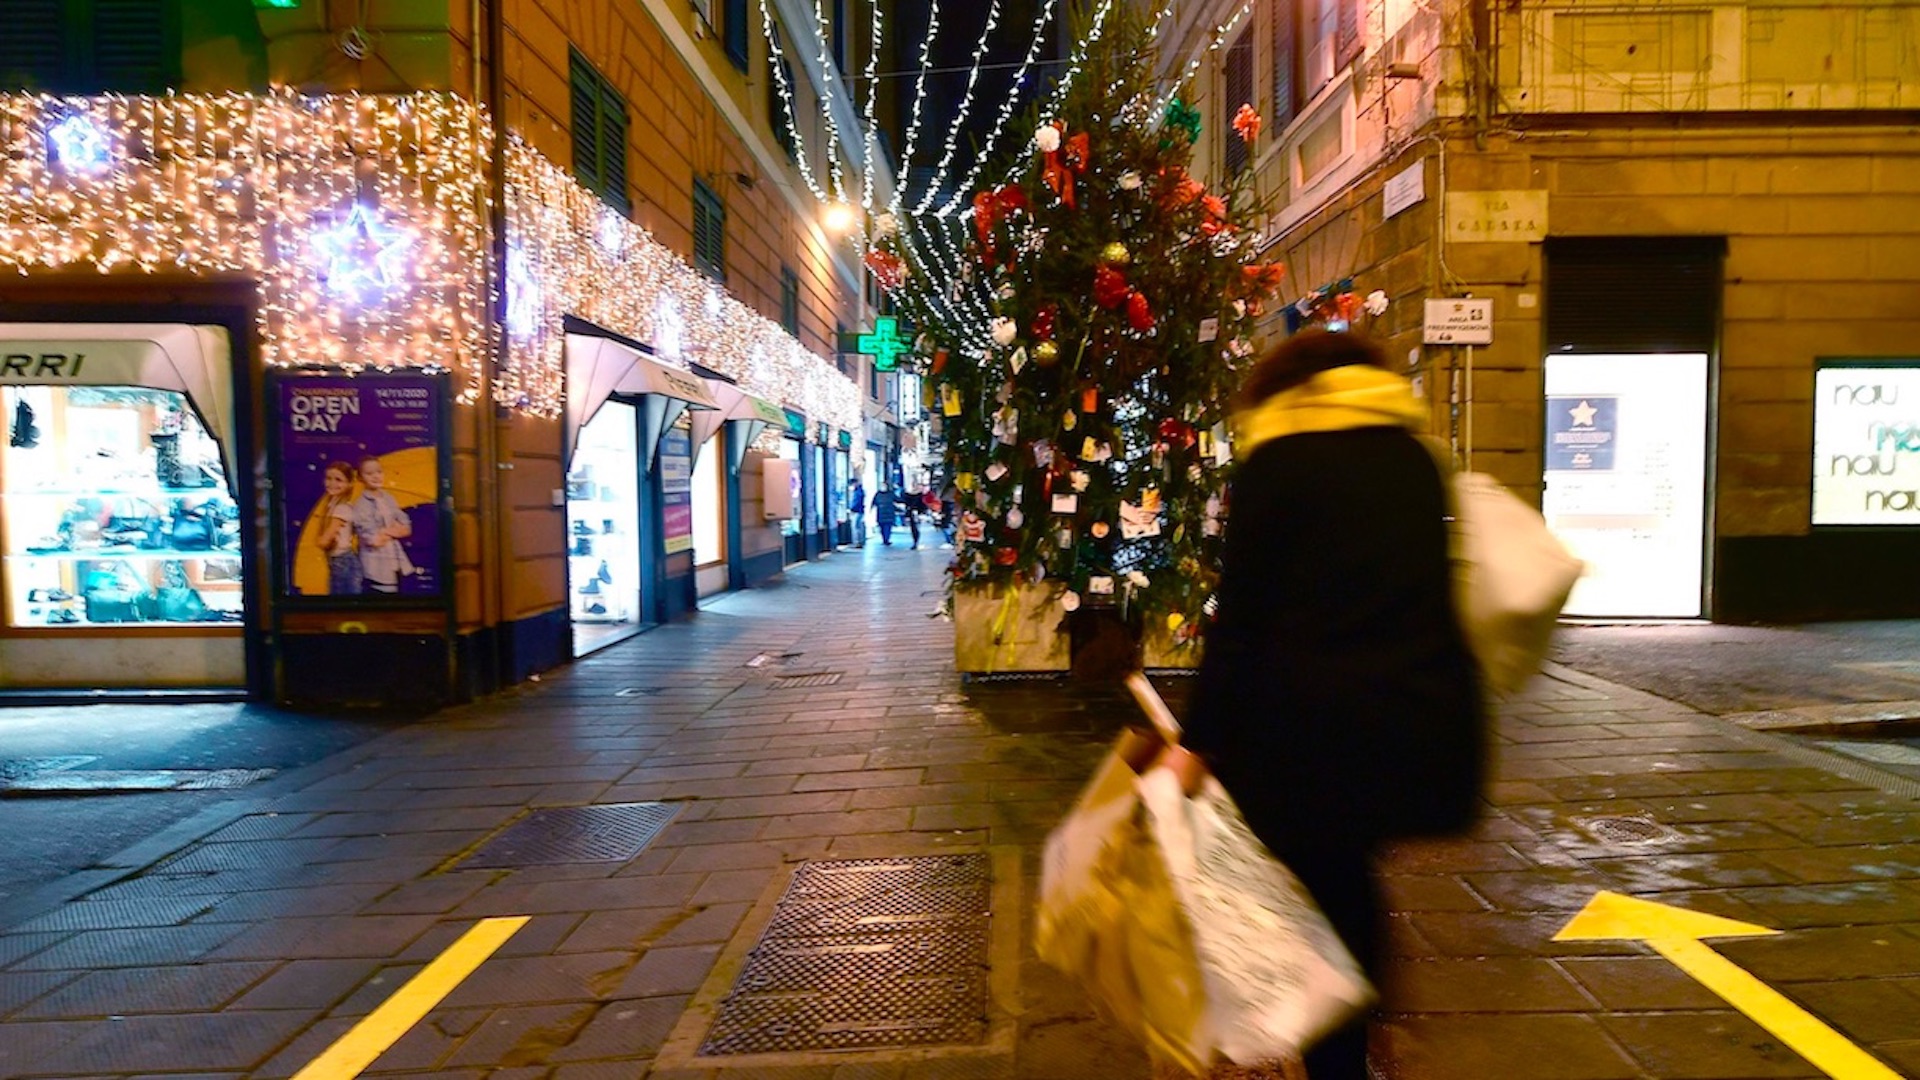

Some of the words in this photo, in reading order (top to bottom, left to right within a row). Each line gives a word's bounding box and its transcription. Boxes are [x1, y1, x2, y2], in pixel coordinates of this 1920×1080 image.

[1834, 384, 1898, 405] nau
[291, 396, 360, 414] OPEN
[291, 414, 341, 431] DAY
[1832, 454, 1895, 476] nau
